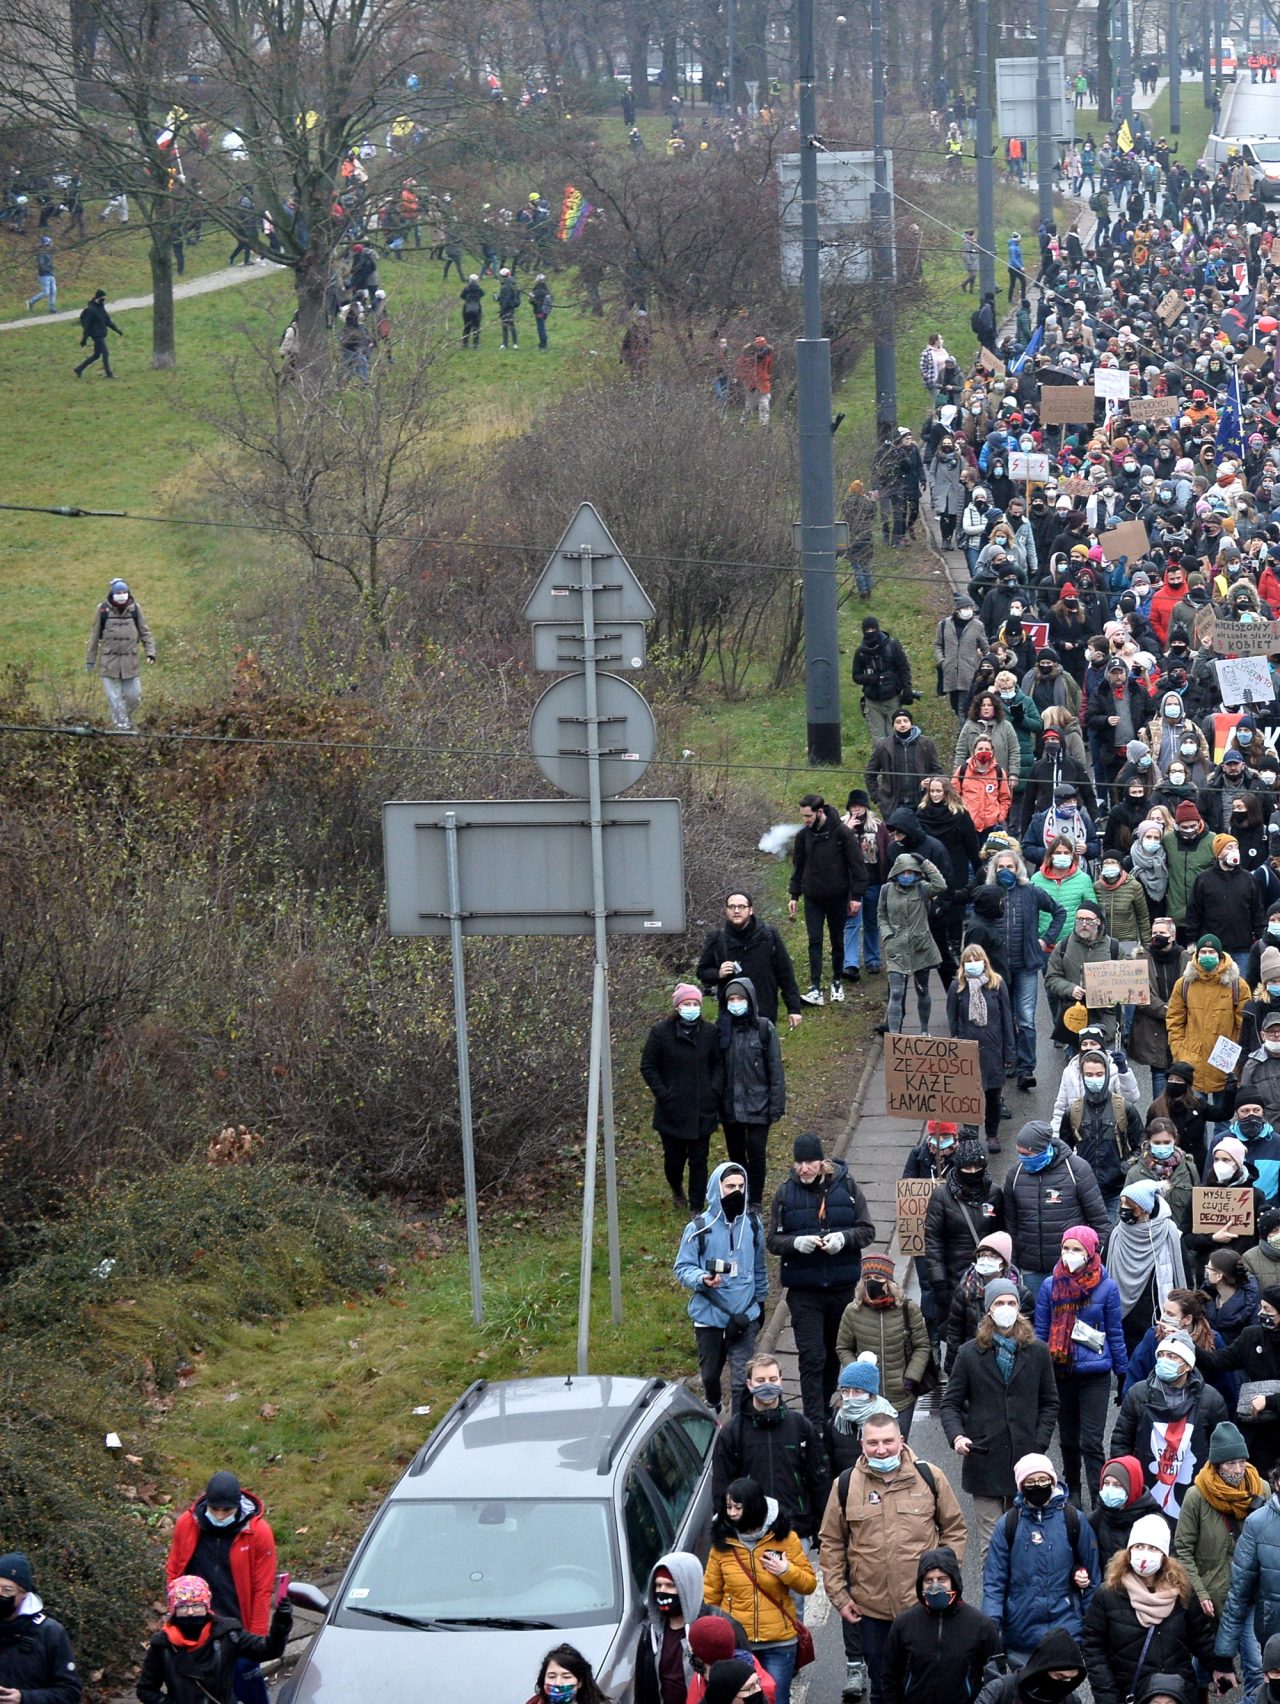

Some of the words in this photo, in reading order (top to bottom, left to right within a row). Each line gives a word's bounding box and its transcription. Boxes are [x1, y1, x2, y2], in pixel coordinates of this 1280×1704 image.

[1228, 640, 1272, 651] KOBIET
[892, 1037, 960, 1059] KACZOR
[893, 1057, 913, 1073] ZE
[915, 1057, 974, 1076] ZŁOŚCI
[889, 1092, 937, 1113] ŁAMAĆ
[940, 1096, 981, 1114] KOŚCI
